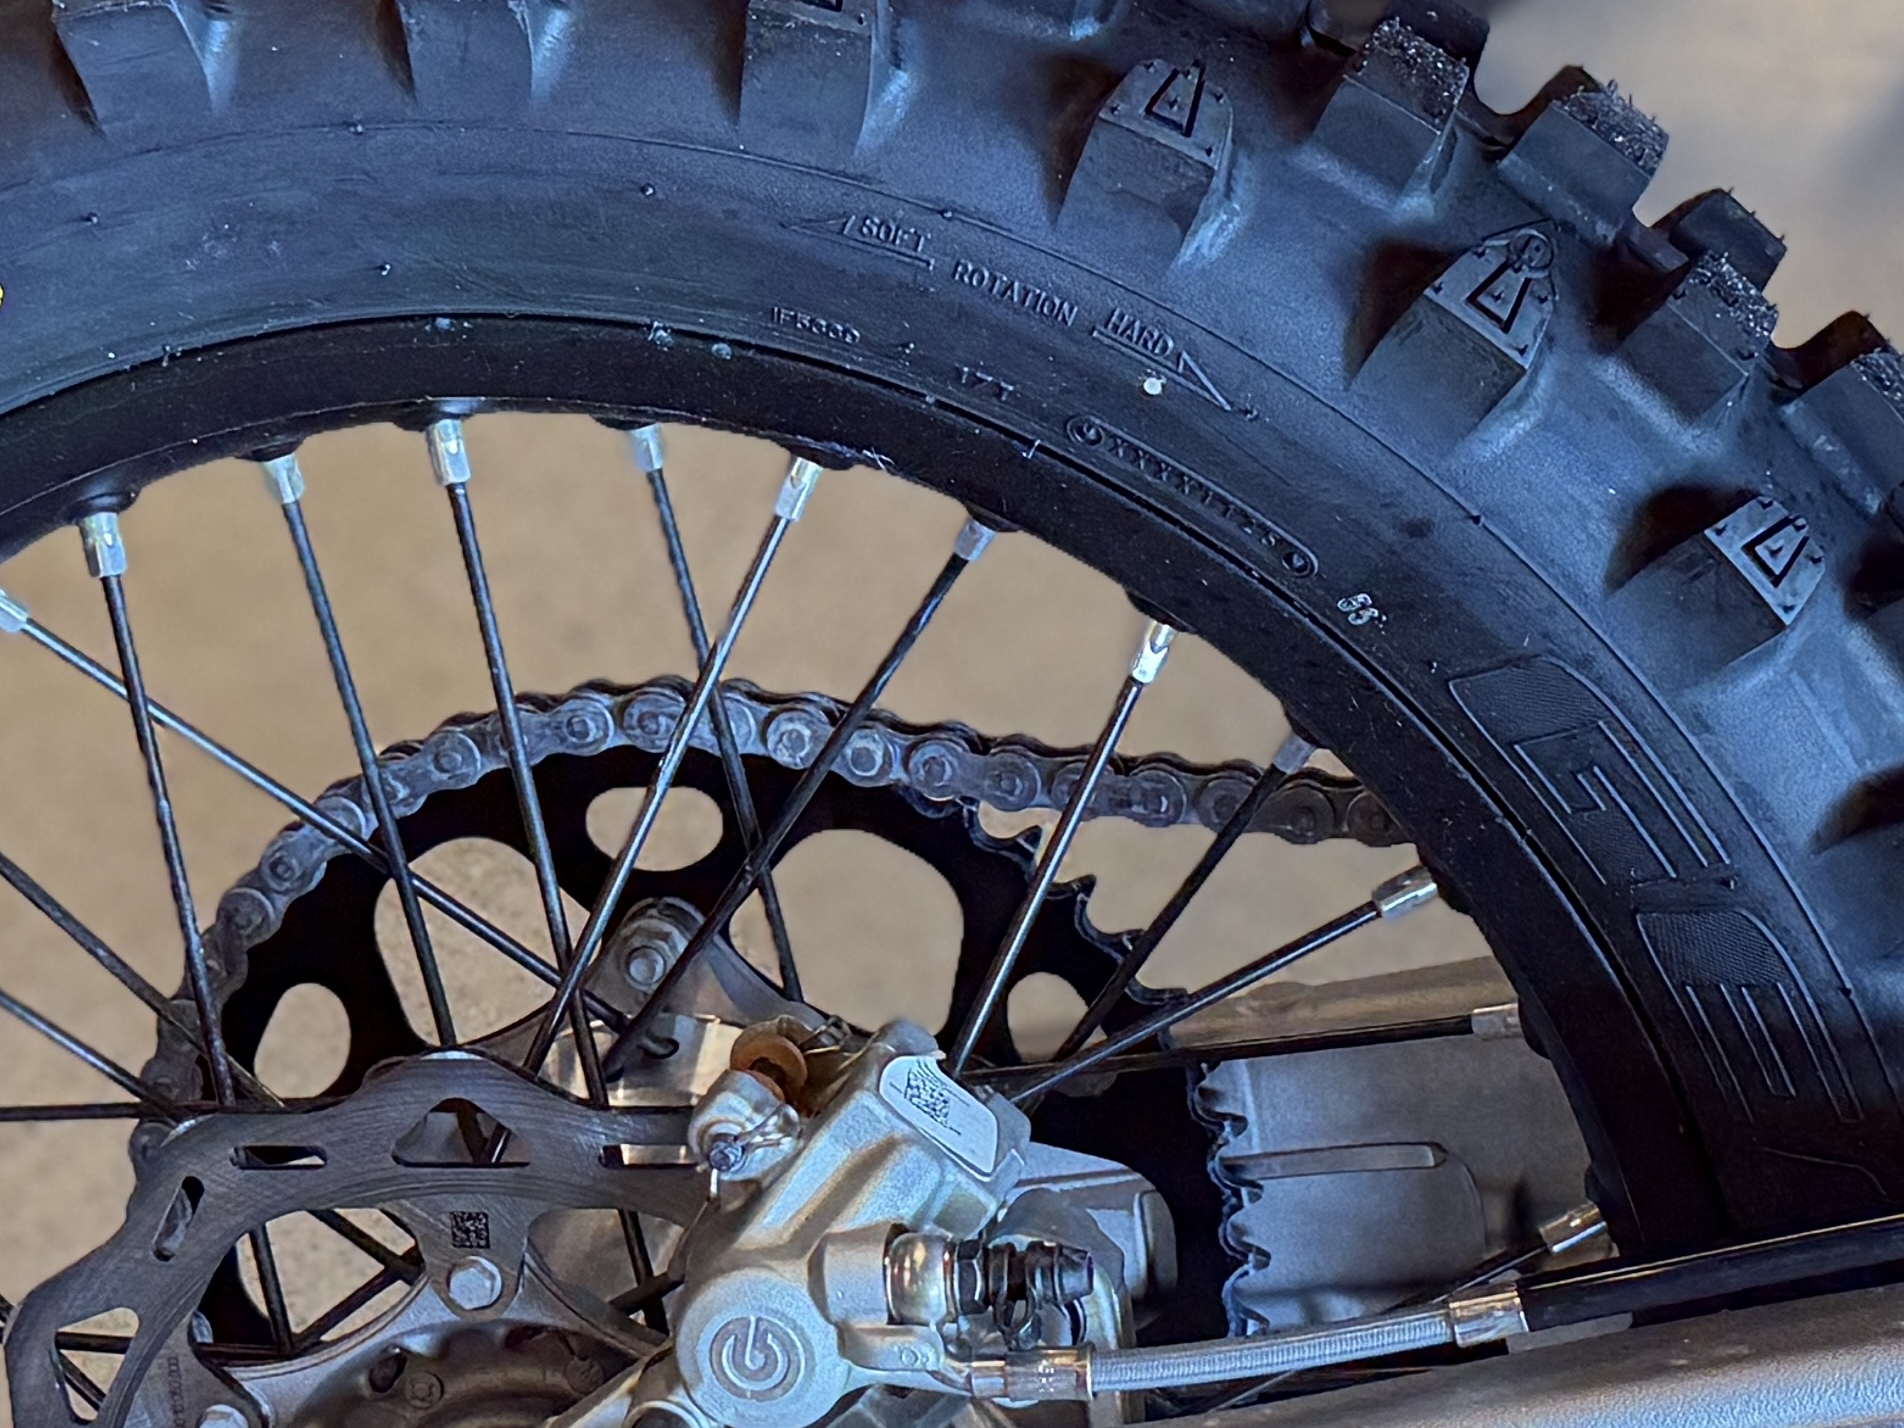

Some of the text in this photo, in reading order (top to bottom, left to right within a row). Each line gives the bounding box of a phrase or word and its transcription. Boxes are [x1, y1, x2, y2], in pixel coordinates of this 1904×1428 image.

[860, 216, 932, 253] SOFT
[953, 260, 1079, 327] ROTATION
[1105, 307, 1174, 358] HARD
